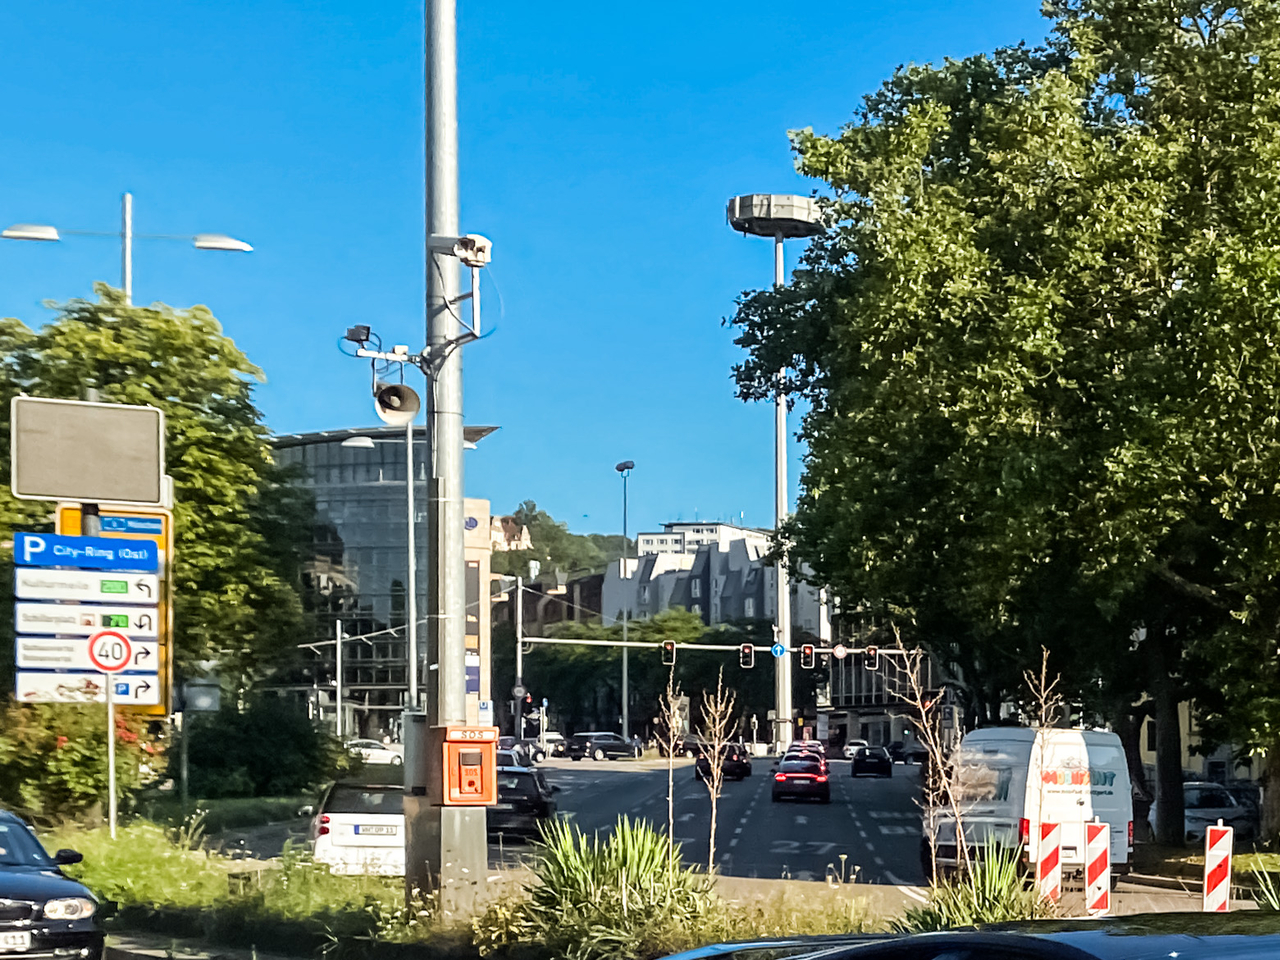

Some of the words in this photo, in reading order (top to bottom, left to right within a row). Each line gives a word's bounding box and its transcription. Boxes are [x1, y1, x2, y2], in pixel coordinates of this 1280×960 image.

[53, 545, 114, 560] City-Ring
[119, 549, 149, 560] (Ost)
[98, 642, 123, 660] 40
[461, 730, 484, 739] SOS
[464, 768, 479, 776] SOS
